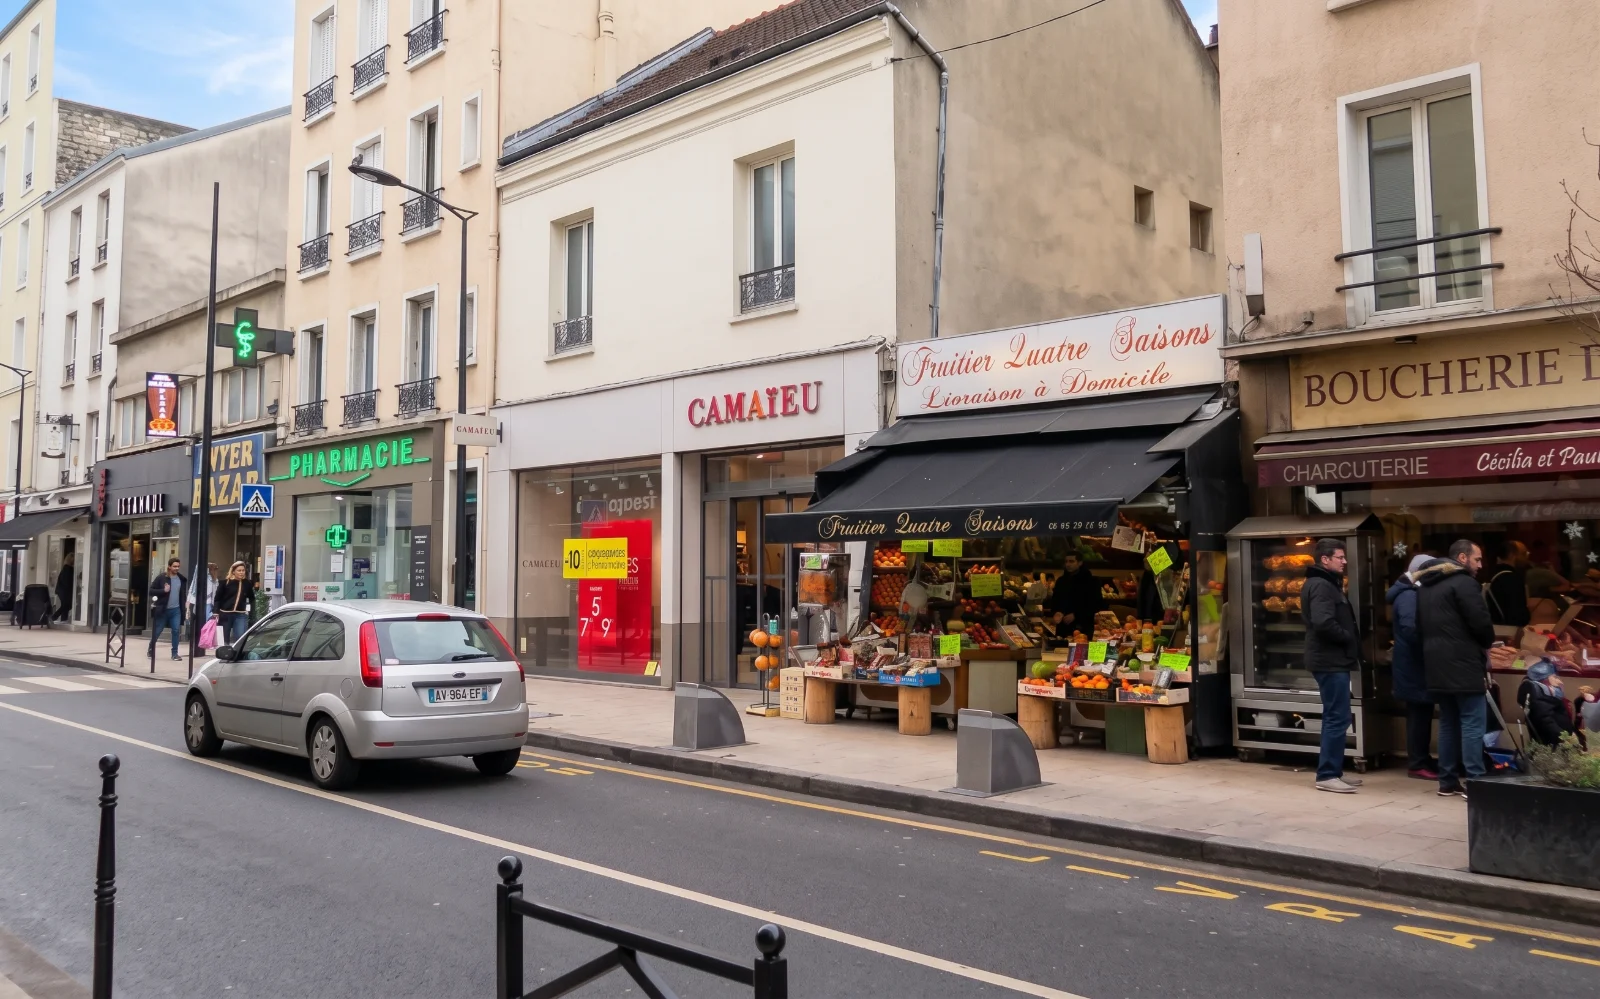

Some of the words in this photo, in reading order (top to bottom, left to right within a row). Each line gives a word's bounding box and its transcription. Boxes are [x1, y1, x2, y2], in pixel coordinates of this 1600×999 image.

[901, 346, 995, 387] Fruitier
[1004, 332, 1092, 370] Quatre
[1110, 315, 1217, 361] Saisons
[1034, 380, 1050, 397] à
[1060, 361, 1173, 395] Domicile
[1304, 348, 1564, 407] BOUCHERIE
[290, 437, 415, 479] PHARMACIE
[1283, 456, 1429, 483] CHARCUTERIE
[1476, 447, 1532, 472] Cécilia
[1537, 448, 1556, 468] et
[818, 514, 887, 539] Fruitier
[894, 511, 952, 534] Quatre
[965, 509, 1039, 536] Saisons
